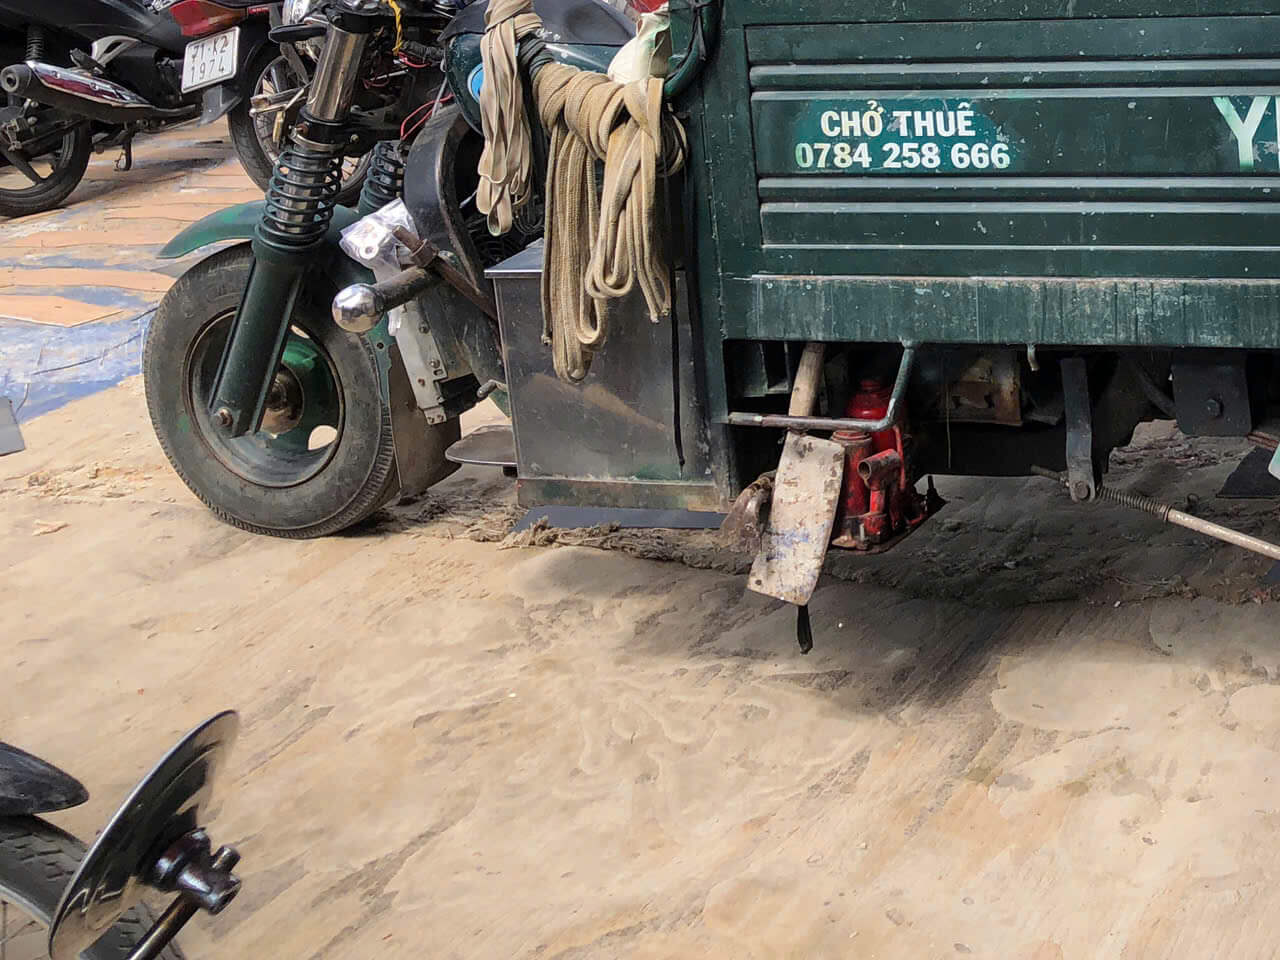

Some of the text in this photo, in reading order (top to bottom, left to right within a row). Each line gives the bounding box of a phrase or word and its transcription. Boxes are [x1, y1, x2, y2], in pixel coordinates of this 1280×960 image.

[820, 100, 976, 137] CHỞ THUÊ
[795, 142, 1010, 169] 0784 258 666
